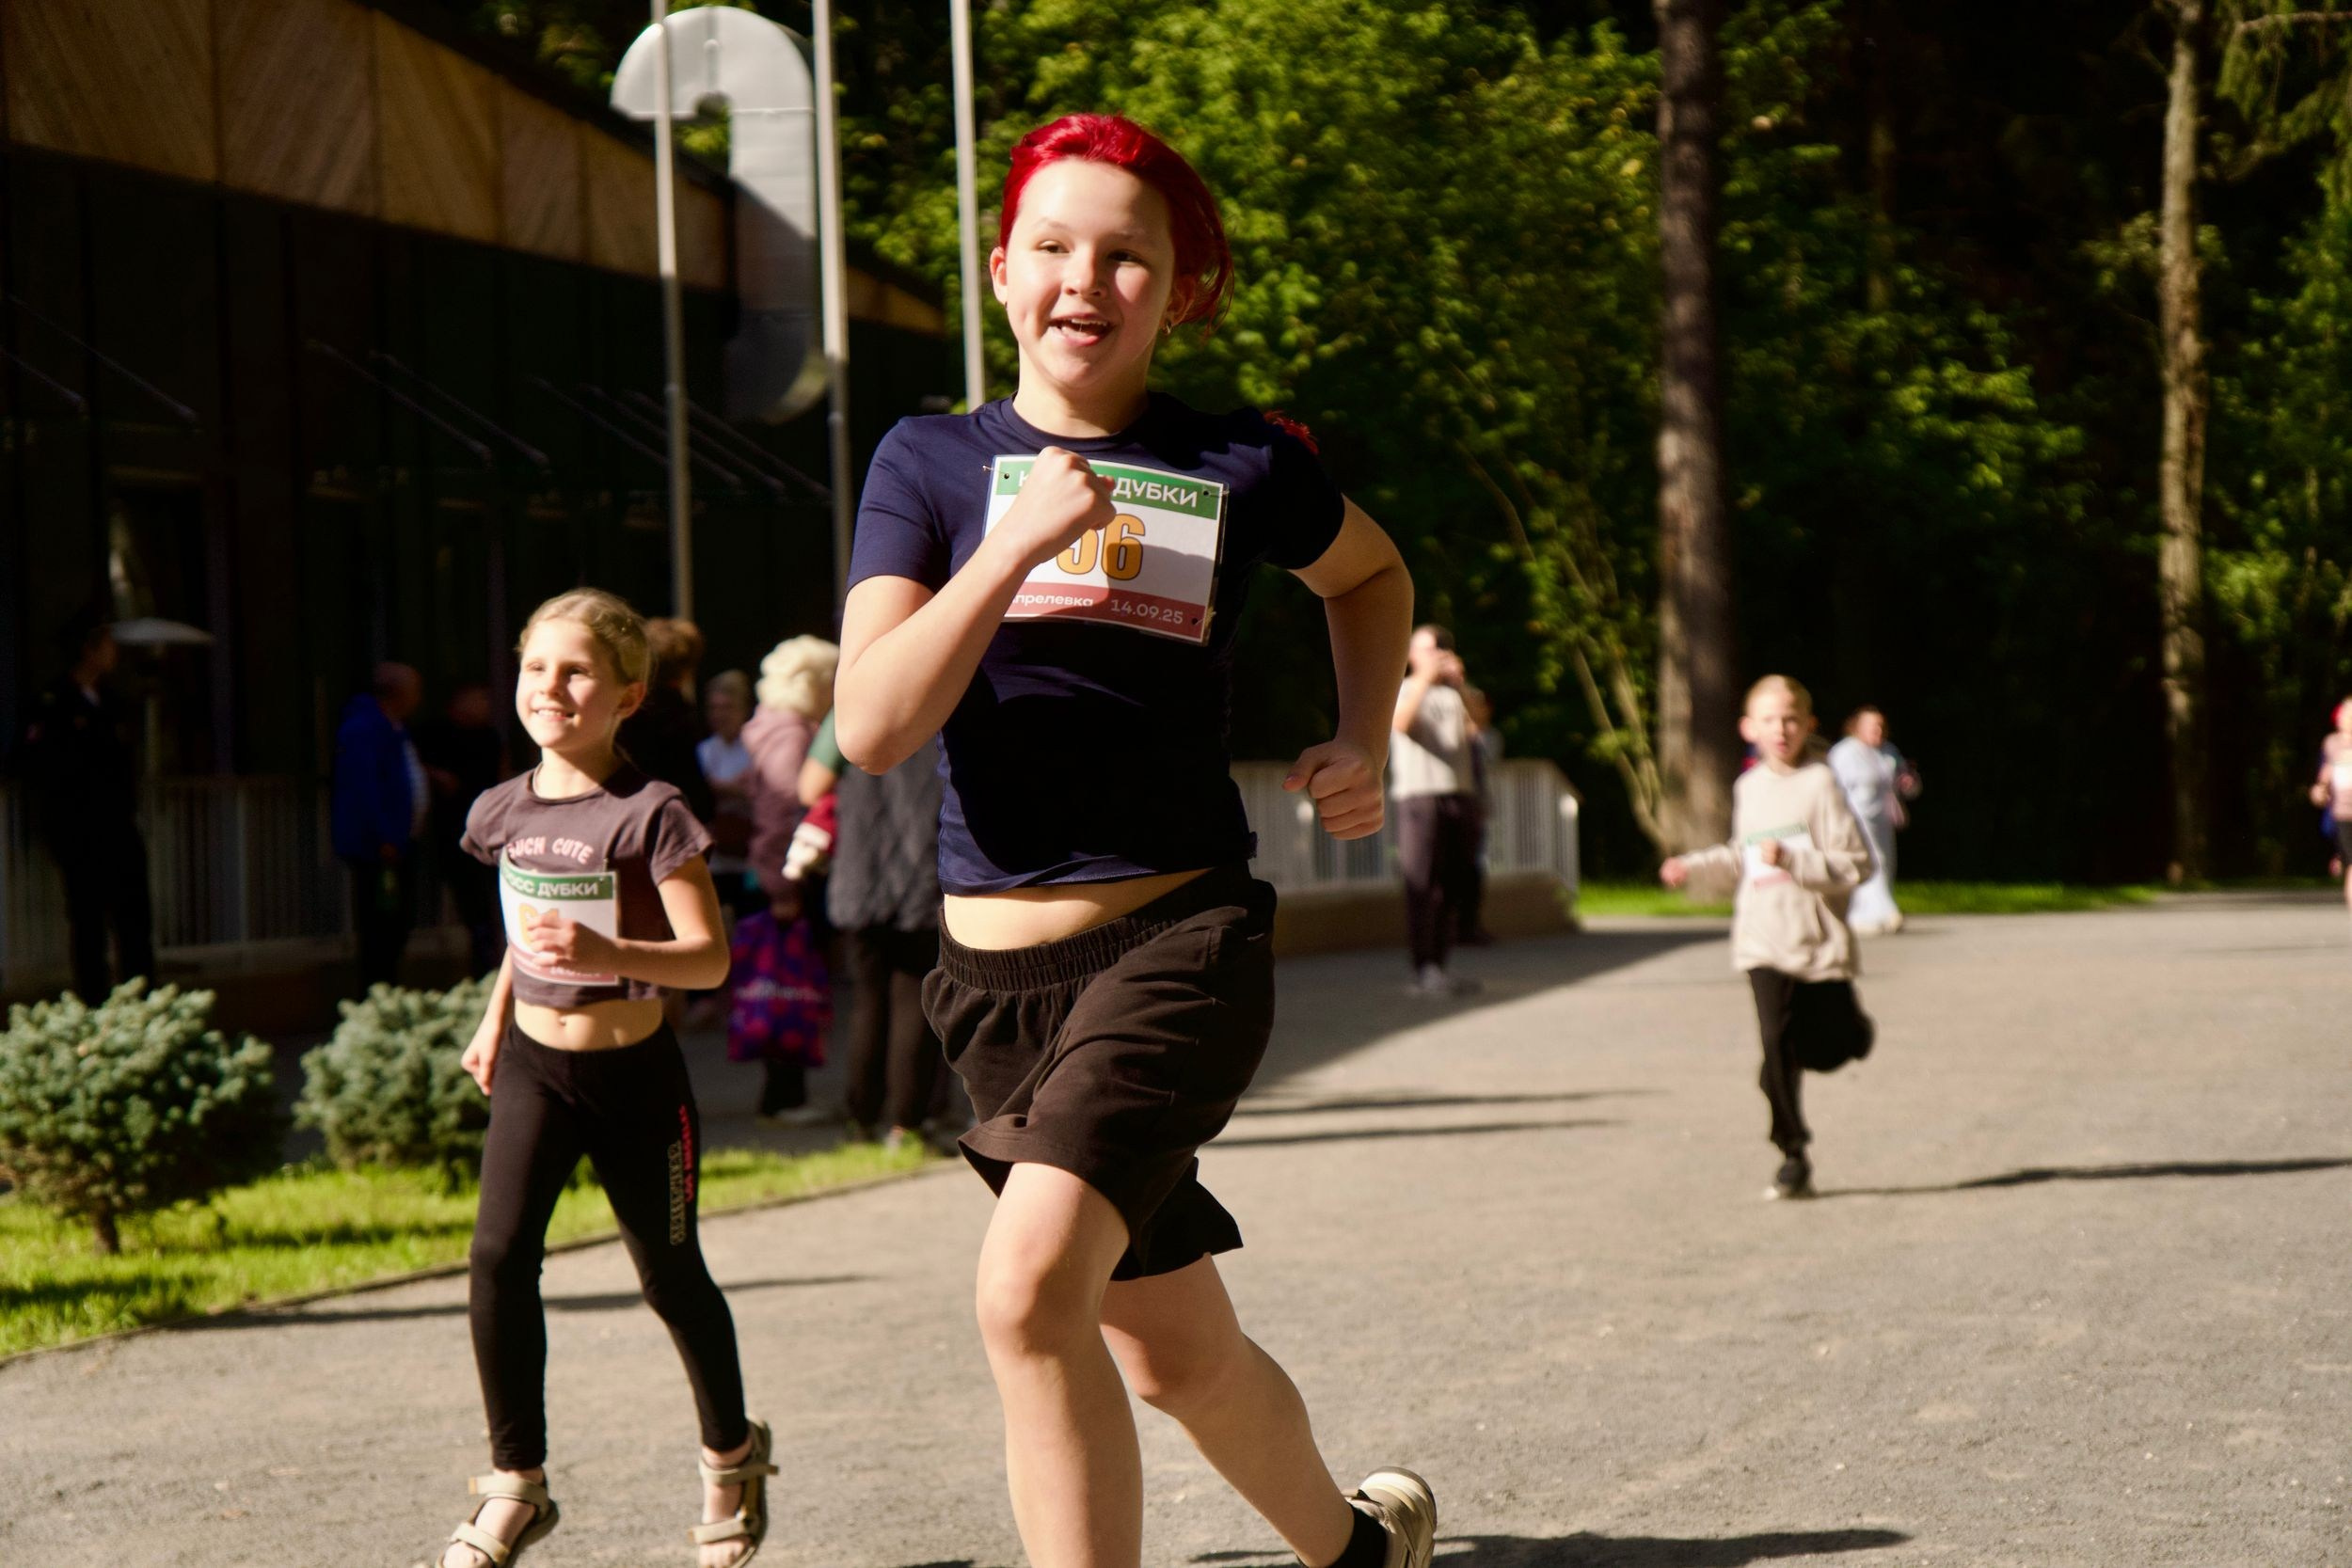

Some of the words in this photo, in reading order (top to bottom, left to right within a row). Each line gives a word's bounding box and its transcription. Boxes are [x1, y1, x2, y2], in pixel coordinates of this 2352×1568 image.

[1113, 477, 1198, 508] ДУБКИ
[1012, 594, 1094, 608] прелевка
[1111, 599, 1184, 625] 14.09.25
[552, 839, 593, 864] CUTE
[537, 882, 597, 896] ДУБКИ
